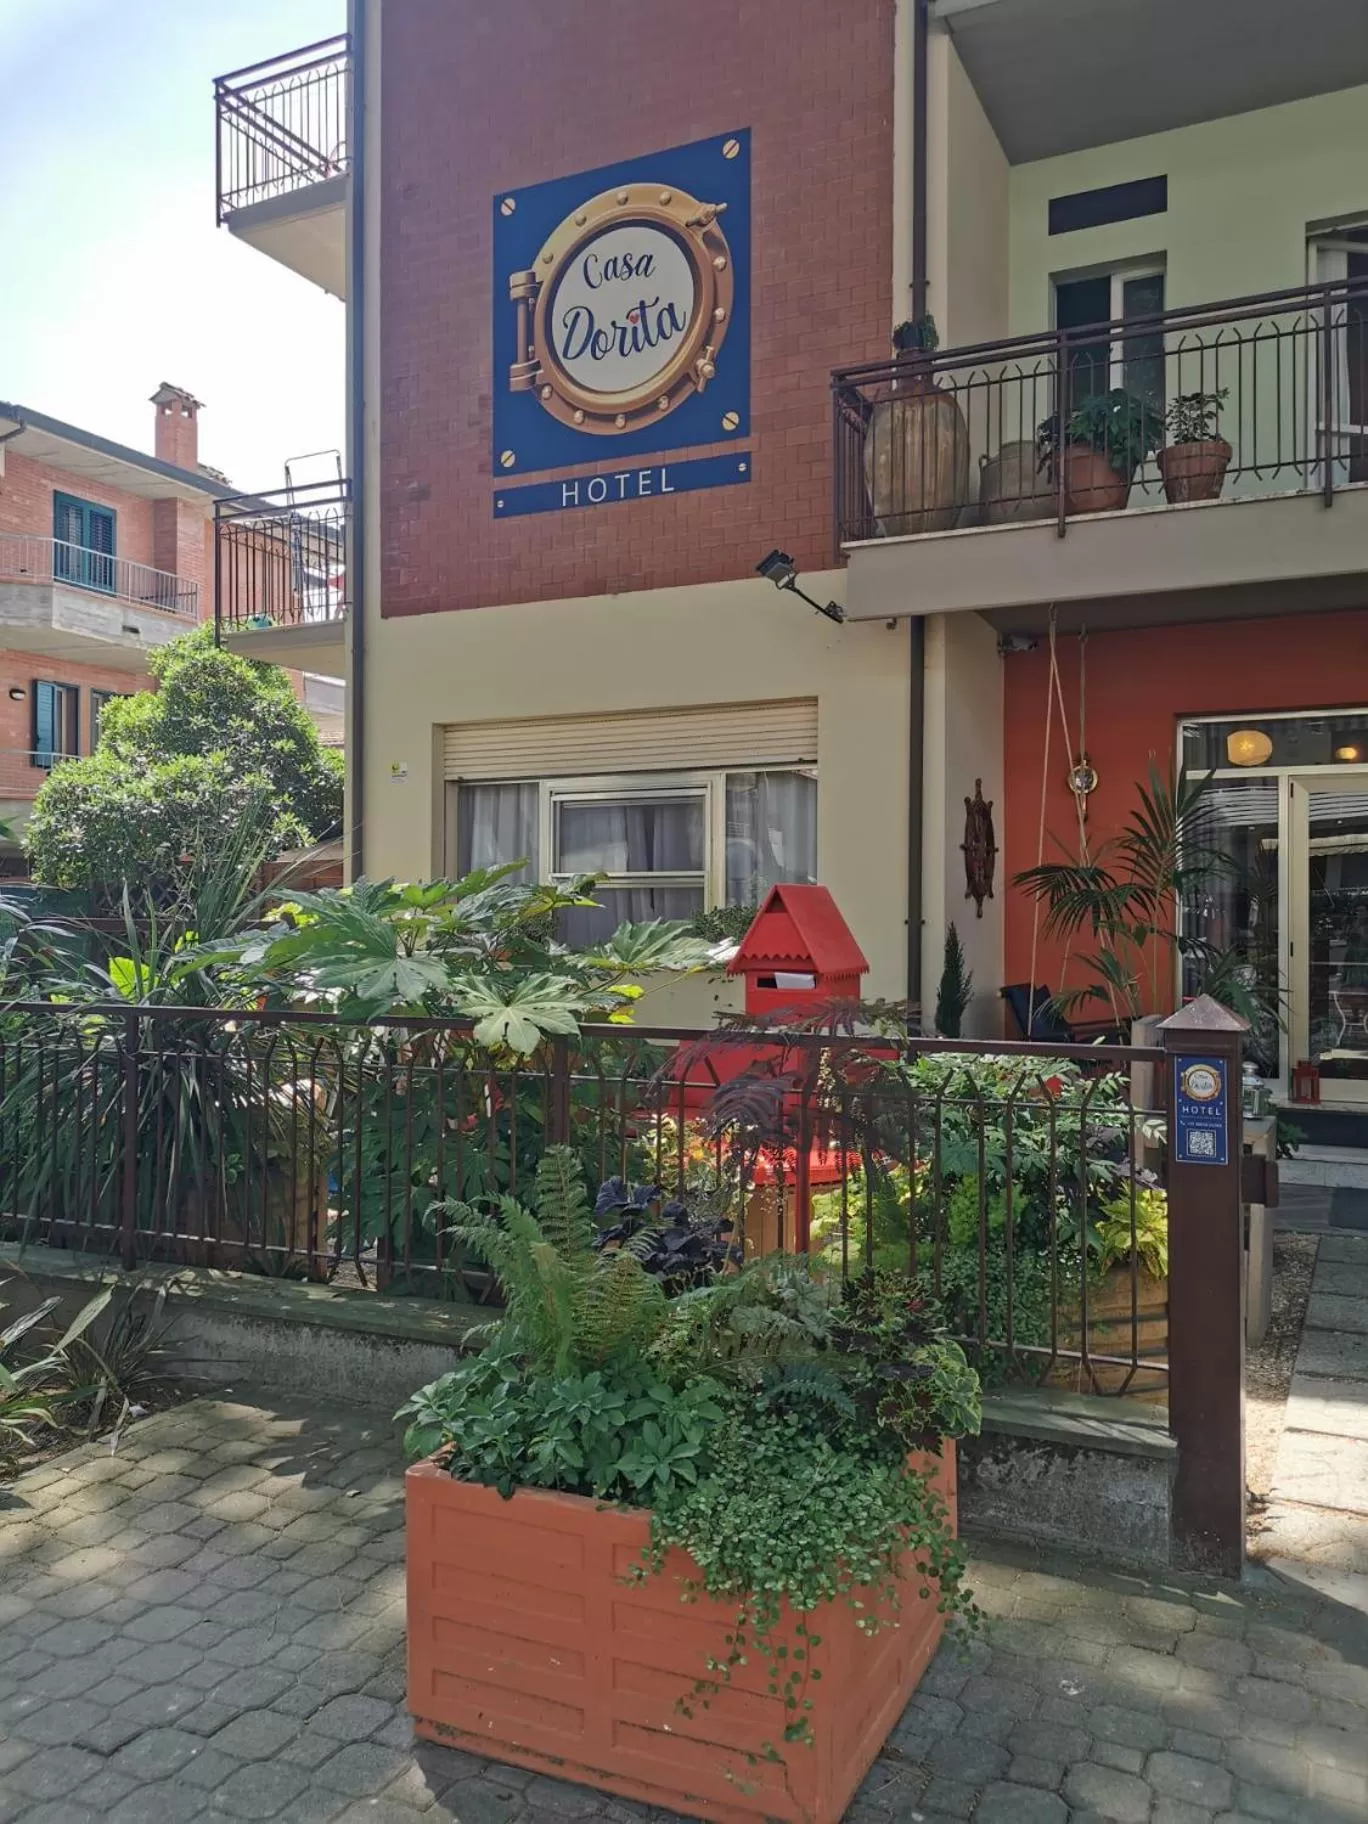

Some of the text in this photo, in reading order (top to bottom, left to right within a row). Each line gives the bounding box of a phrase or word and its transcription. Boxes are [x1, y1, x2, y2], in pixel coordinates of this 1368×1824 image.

[584, 252, 655, 289] Casa
[562, 296, 686, 361] Dorita
[562, 468, 675, 507] HOTEL
[1182, 1105, 1221, 1116] HOTEL
